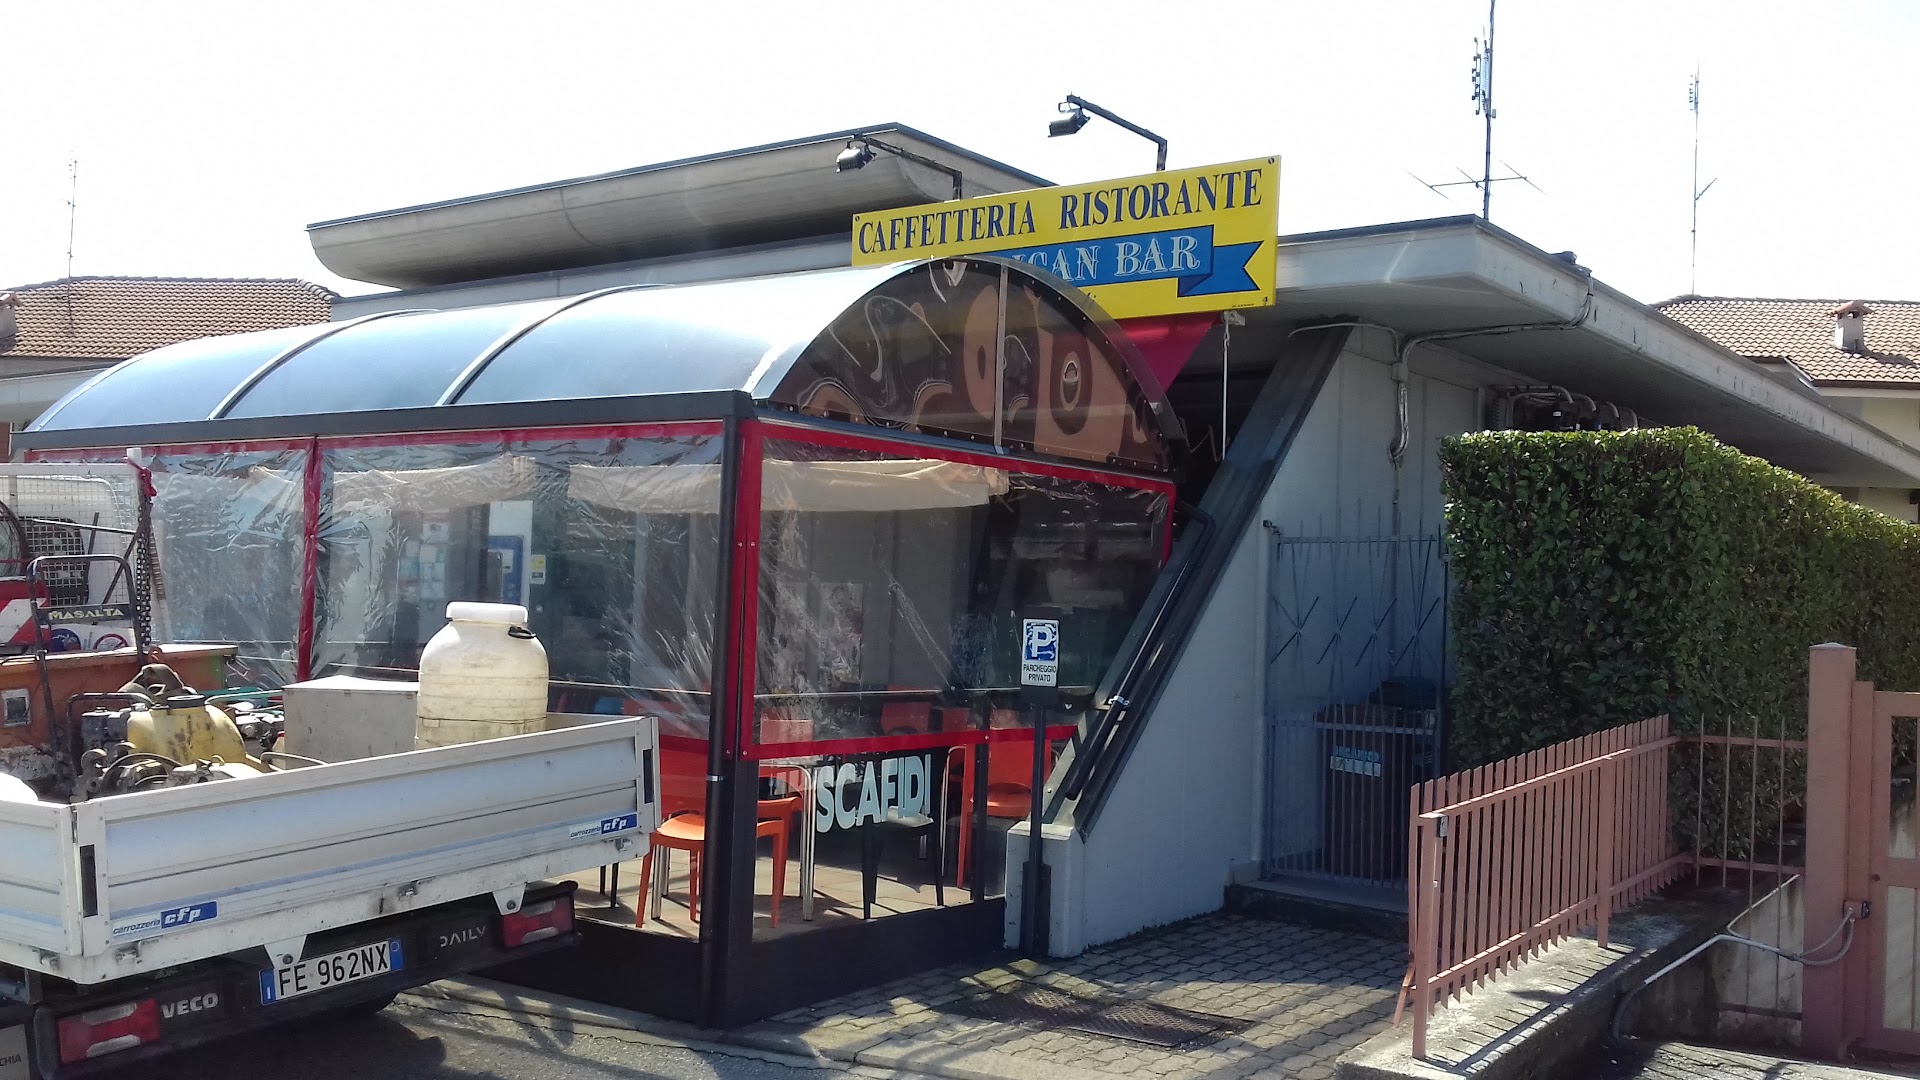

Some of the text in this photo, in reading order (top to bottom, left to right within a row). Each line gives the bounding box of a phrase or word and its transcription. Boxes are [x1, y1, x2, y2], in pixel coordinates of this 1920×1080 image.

[858, 168, 1263, 255] CAFFETTERIA RISTORANTE
[1114, 235, 1201, 277] BAR
[48, 608, 125, 620] MASALTA
[1023, 664, 1057, 674] PARCHEGGIO
[1028, 673, 1051, 682] PRIVATO
[816, 754, 932, 833] SCAFIDI
[602, 818, 628, 831] cfp
[113, 907, 201, 935] carrozzeria cfp
[279, 964, 308, 996] FE
[317, 943, 388, 986] 962NX
